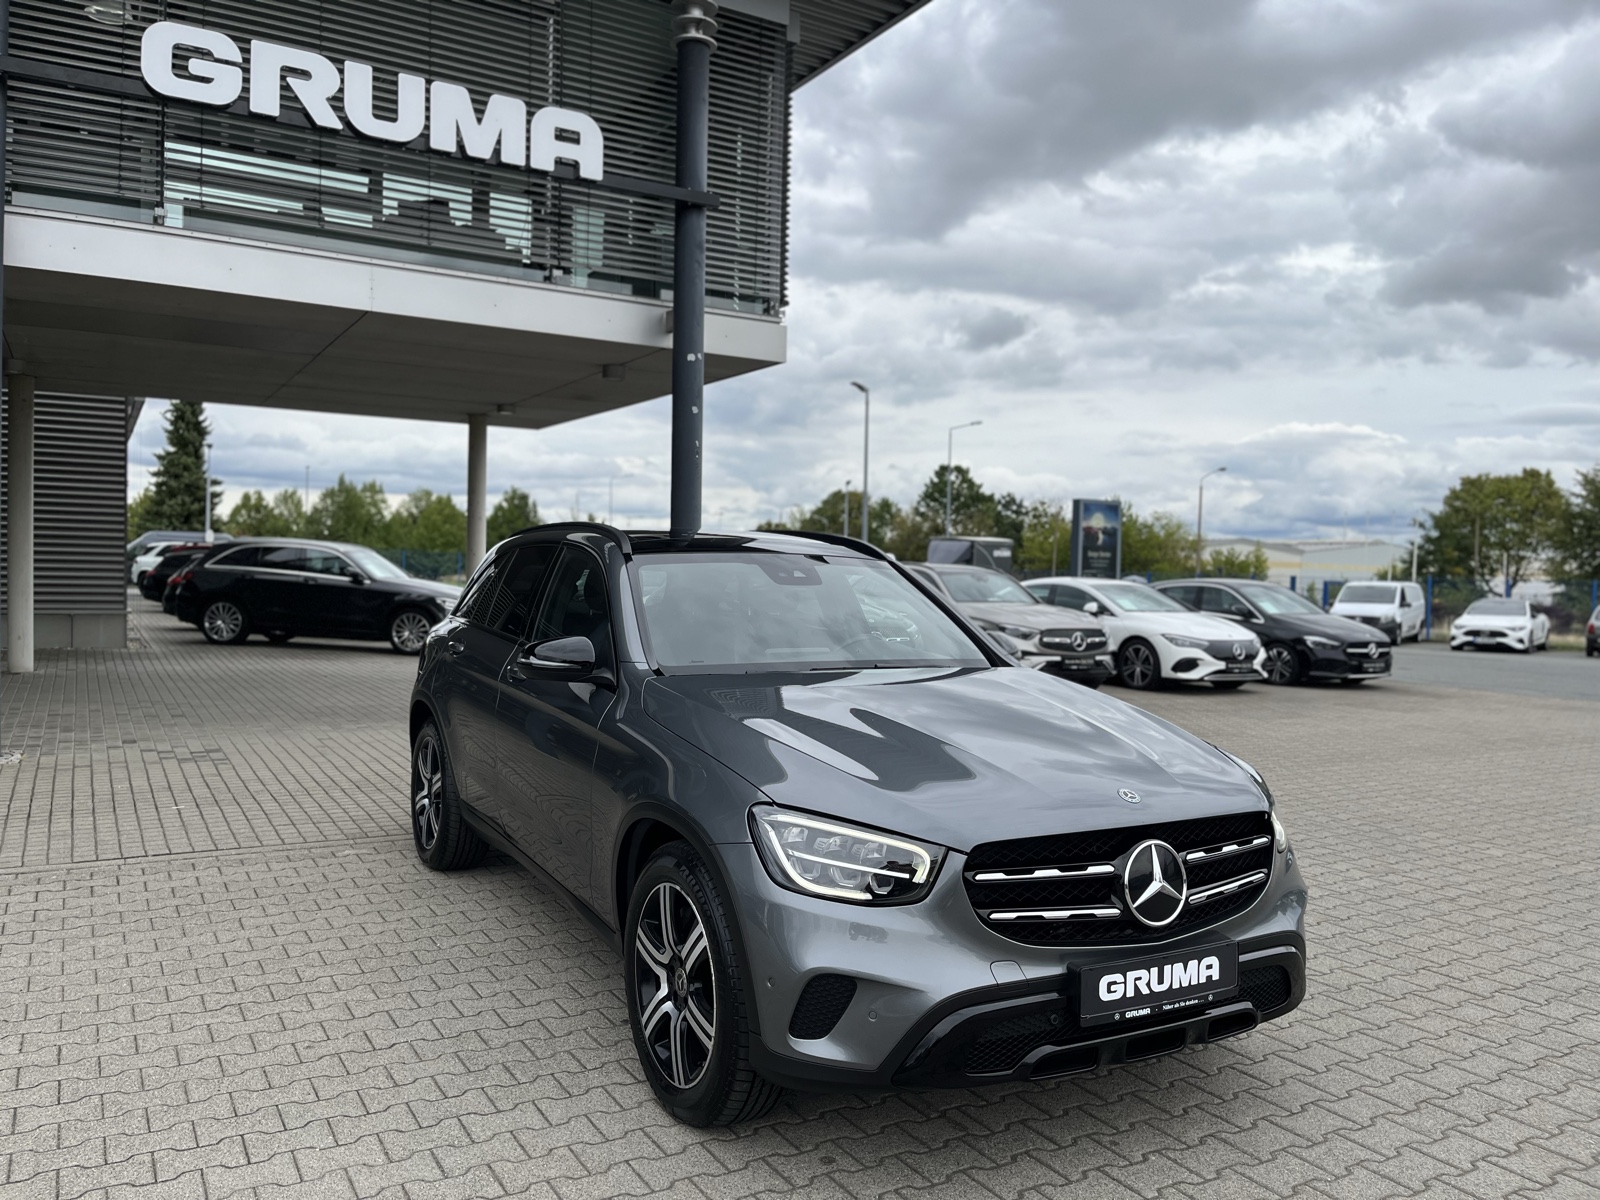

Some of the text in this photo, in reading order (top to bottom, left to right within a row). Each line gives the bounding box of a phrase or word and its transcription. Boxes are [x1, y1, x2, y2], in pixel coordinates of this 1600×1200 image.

[140, 21, 605, 182] GRUMA
[1099, 956, 1220, 1001] GRUMA
[1125, 1007, 1151, 1018] GRUMA
